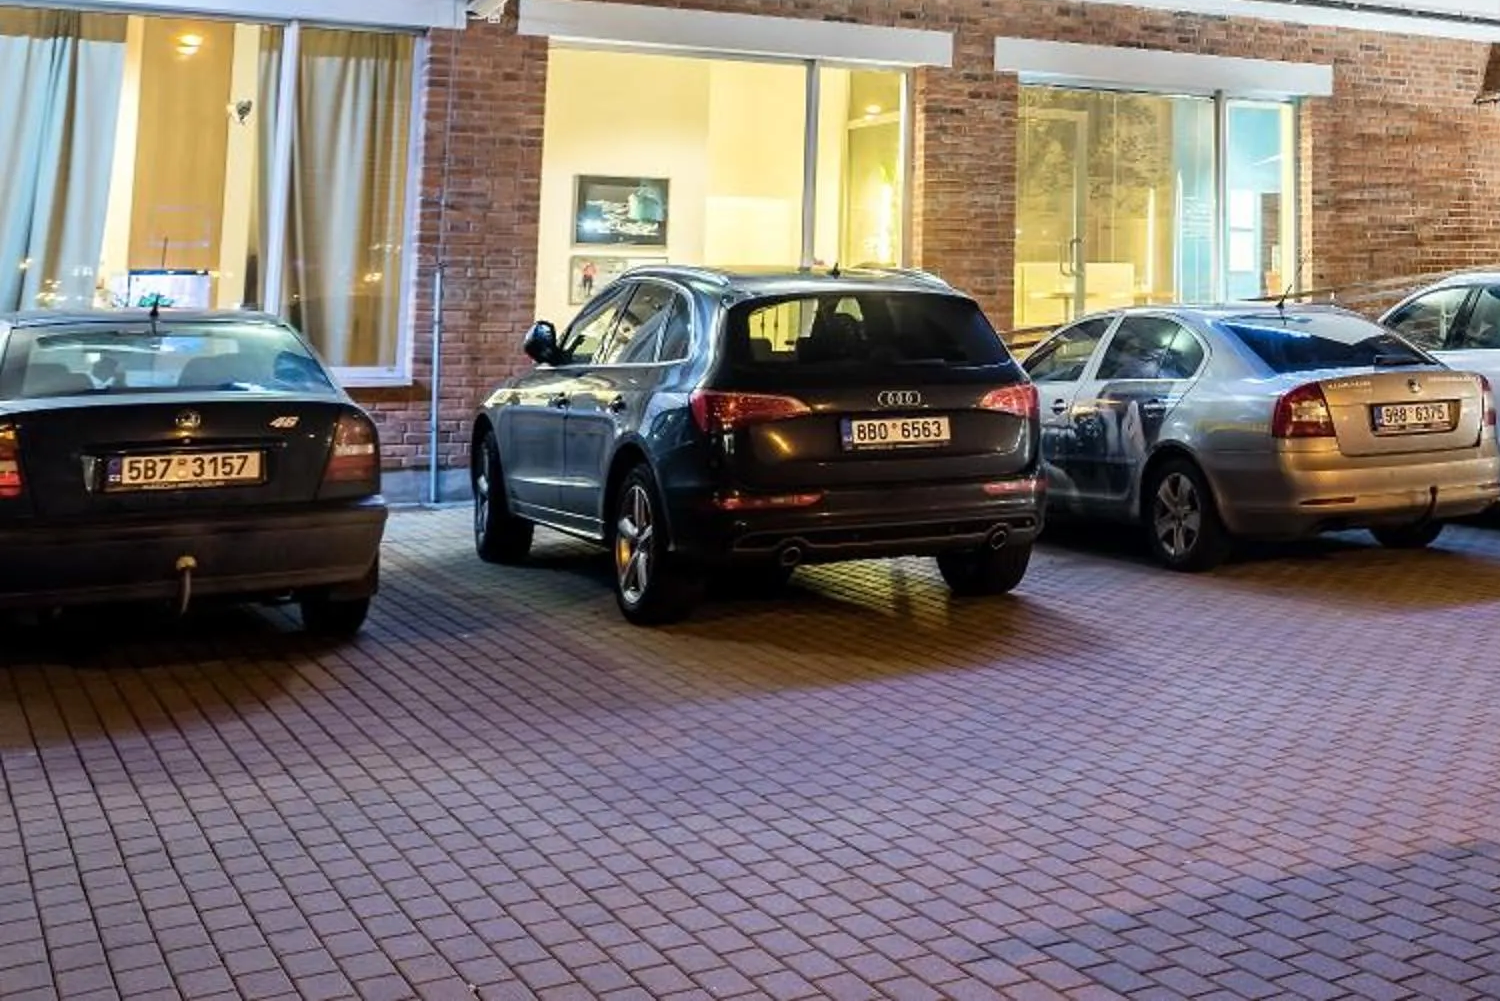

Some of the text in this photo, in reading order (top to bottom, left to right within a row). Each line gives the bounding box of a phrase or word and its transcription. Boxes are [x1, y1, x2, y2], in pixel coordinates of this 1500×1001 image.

[901, 420, 942, 439] 6563
[127, 455, 249, 481] 5B7 3157
